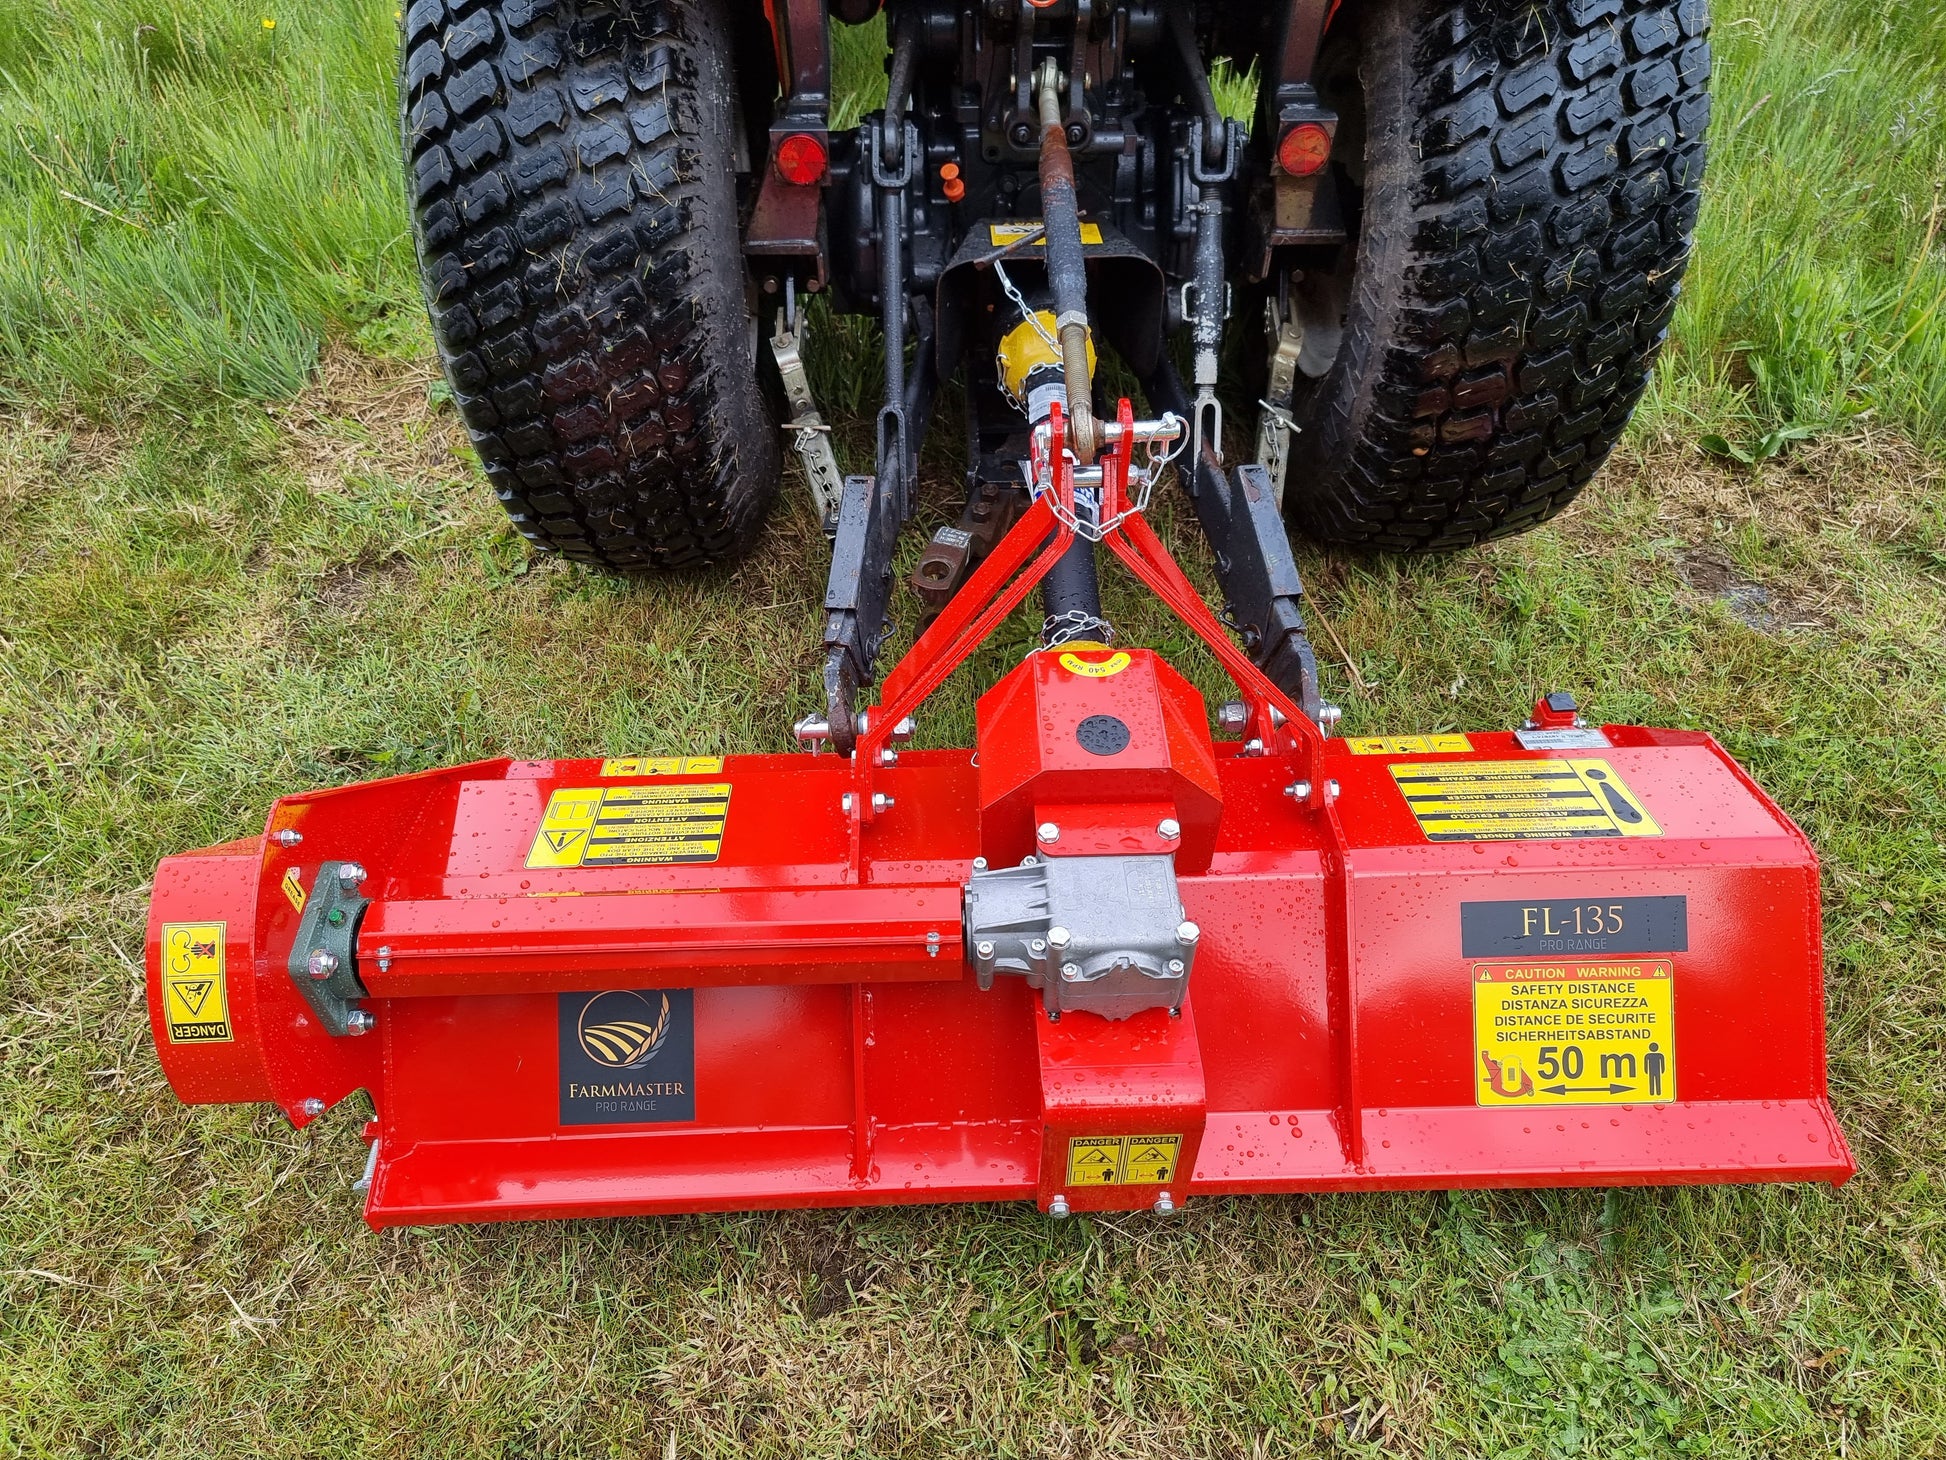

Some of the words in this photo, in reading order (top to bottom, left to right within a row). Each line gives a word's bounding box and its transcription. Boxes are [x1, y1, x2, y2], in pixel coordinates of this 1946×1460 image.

[1066, 660, 1084, 670] RPM
[284, 882, 300, 908] GREASE
[1522, 904, 1624, 936] FL-135
[1539, 939, 1564, 951] PRO
[1567, 938, 1607, 950] RANGE
[1505, 968, 1565, 980] CAUTION
[1577, 967, 1641, 977] WARNING
[1512, 984, 1562, 995] SAFETY
[1569, 983, 1635, 994] DISTANCE
[1502, 1000, 1567, 1010] DISTANZA
[1572, 998, 1648, 1009] SICUREZZA
[1495, 1016, 1561, 1026] DISTANCE
[1566, 1015, 1584, 1025] DE
[1589, 1014, 1656, 1024] SECURITE
[173, 1024, 226, 1037] DANGER
[1496, 1029, 1650, 1042] SICHERHEITSABSTAND
[1538, 1046, 1583, 1080] 50
[1601, 1054, 1635, 1078] m
[596, 1102, 617, 1112] PRO
[620, 1100, 656, 1112] RANGE
